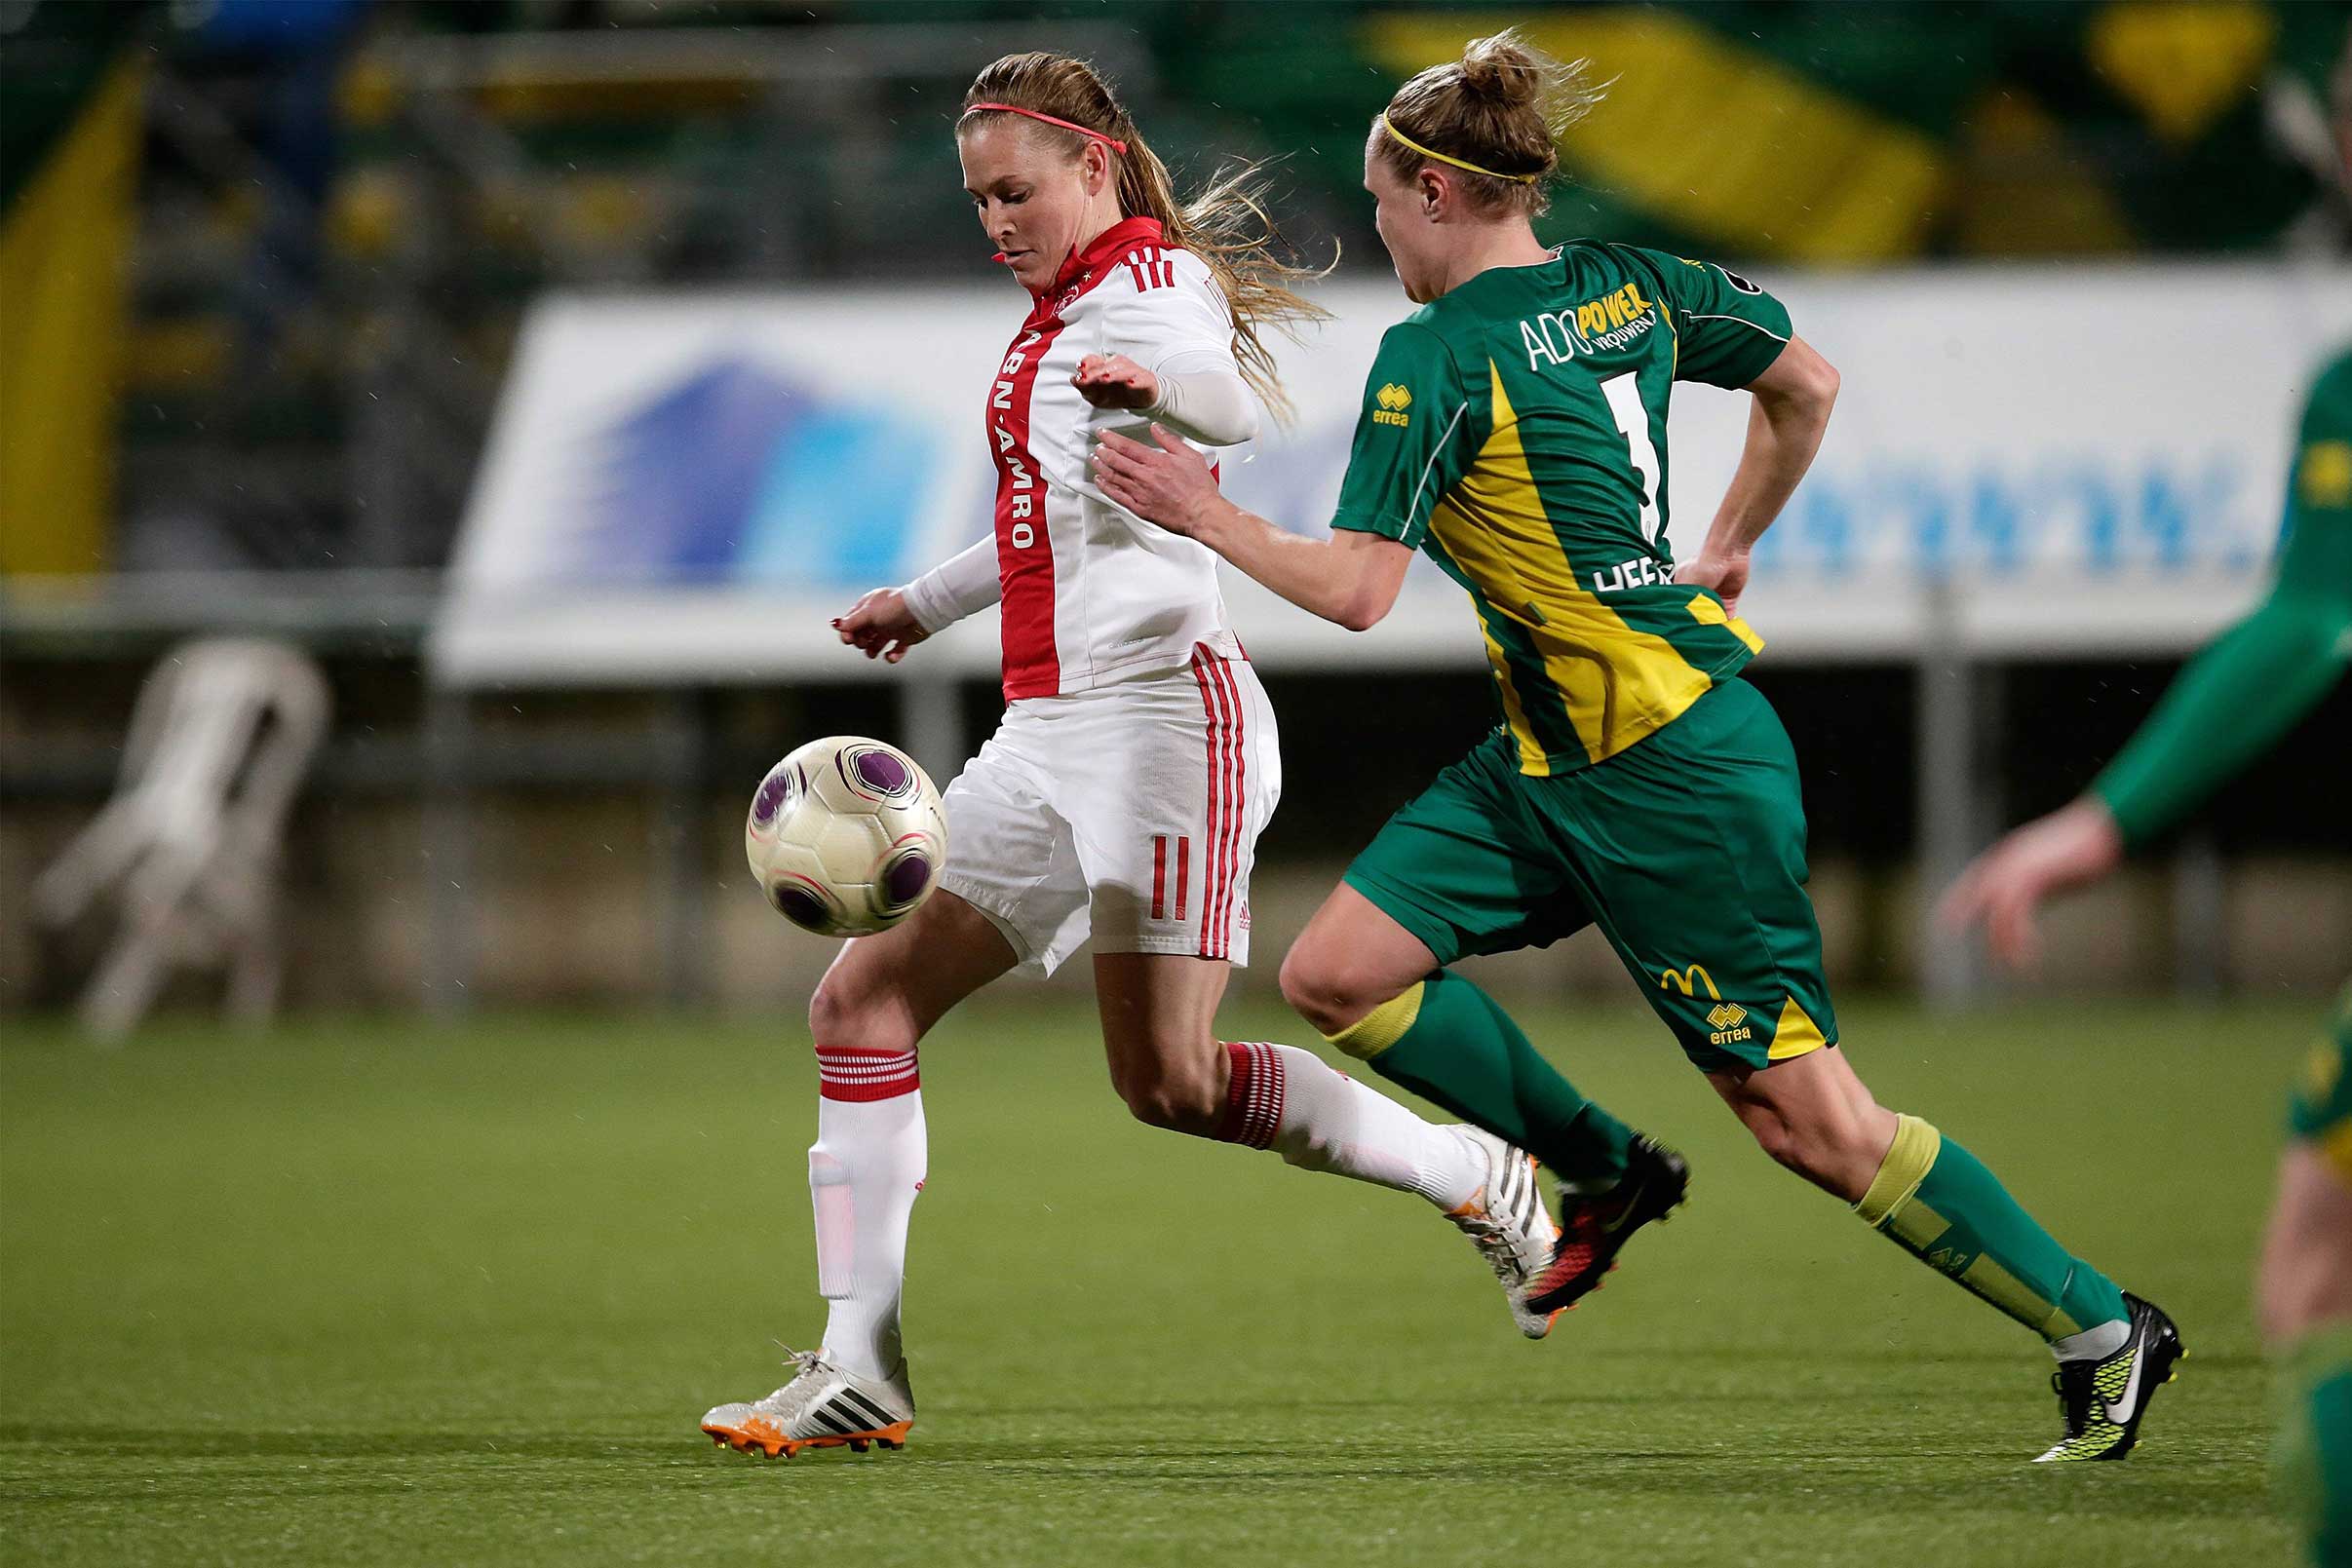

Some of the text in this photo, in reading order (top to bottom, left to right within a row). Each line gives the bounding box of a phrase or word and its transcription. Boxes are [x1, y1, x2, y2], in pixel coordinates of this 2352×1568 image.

[1372, 409, 1409, 427] errea
[1151, 835, 1190, 921] 11
[1710, 1027, 1752, 1045] errea
